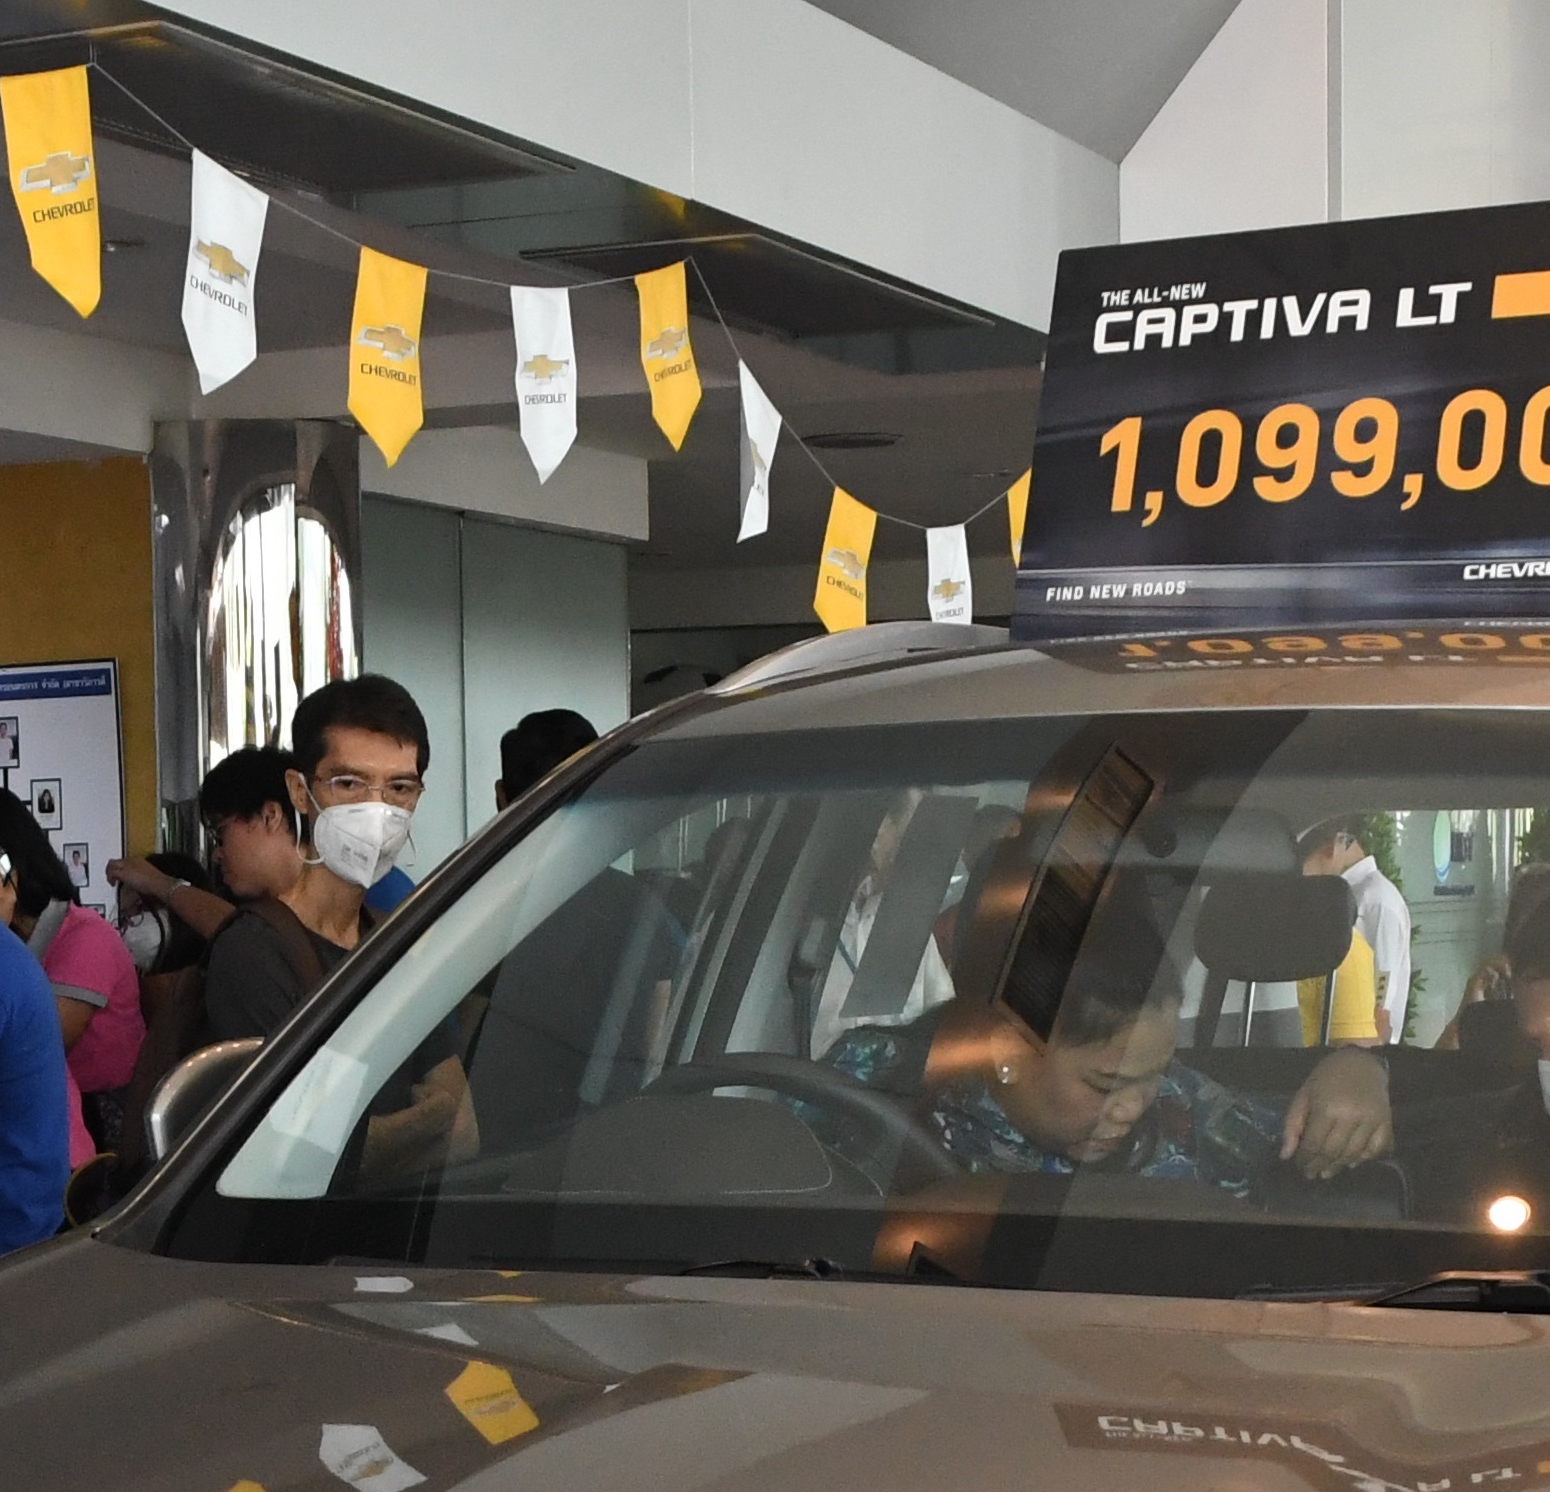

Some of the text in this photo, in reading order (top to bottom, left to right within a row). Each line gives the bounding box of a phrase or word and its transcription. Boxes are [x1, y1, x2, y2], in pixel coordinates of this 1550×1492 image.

[189, 275, 249, 317] CHEVROLET
[1101, 282, 1207, 307] THE ALL-NEW
[1093, 281, 1473, 355] CAPTIVA LT
[360, 363, 418, 386] CHEVROLET
[524, 393, 568, 405] CHEVROLET
[1046, 586, 1084, 602] FIND
[1089, 583, 1128, 600] NEW
